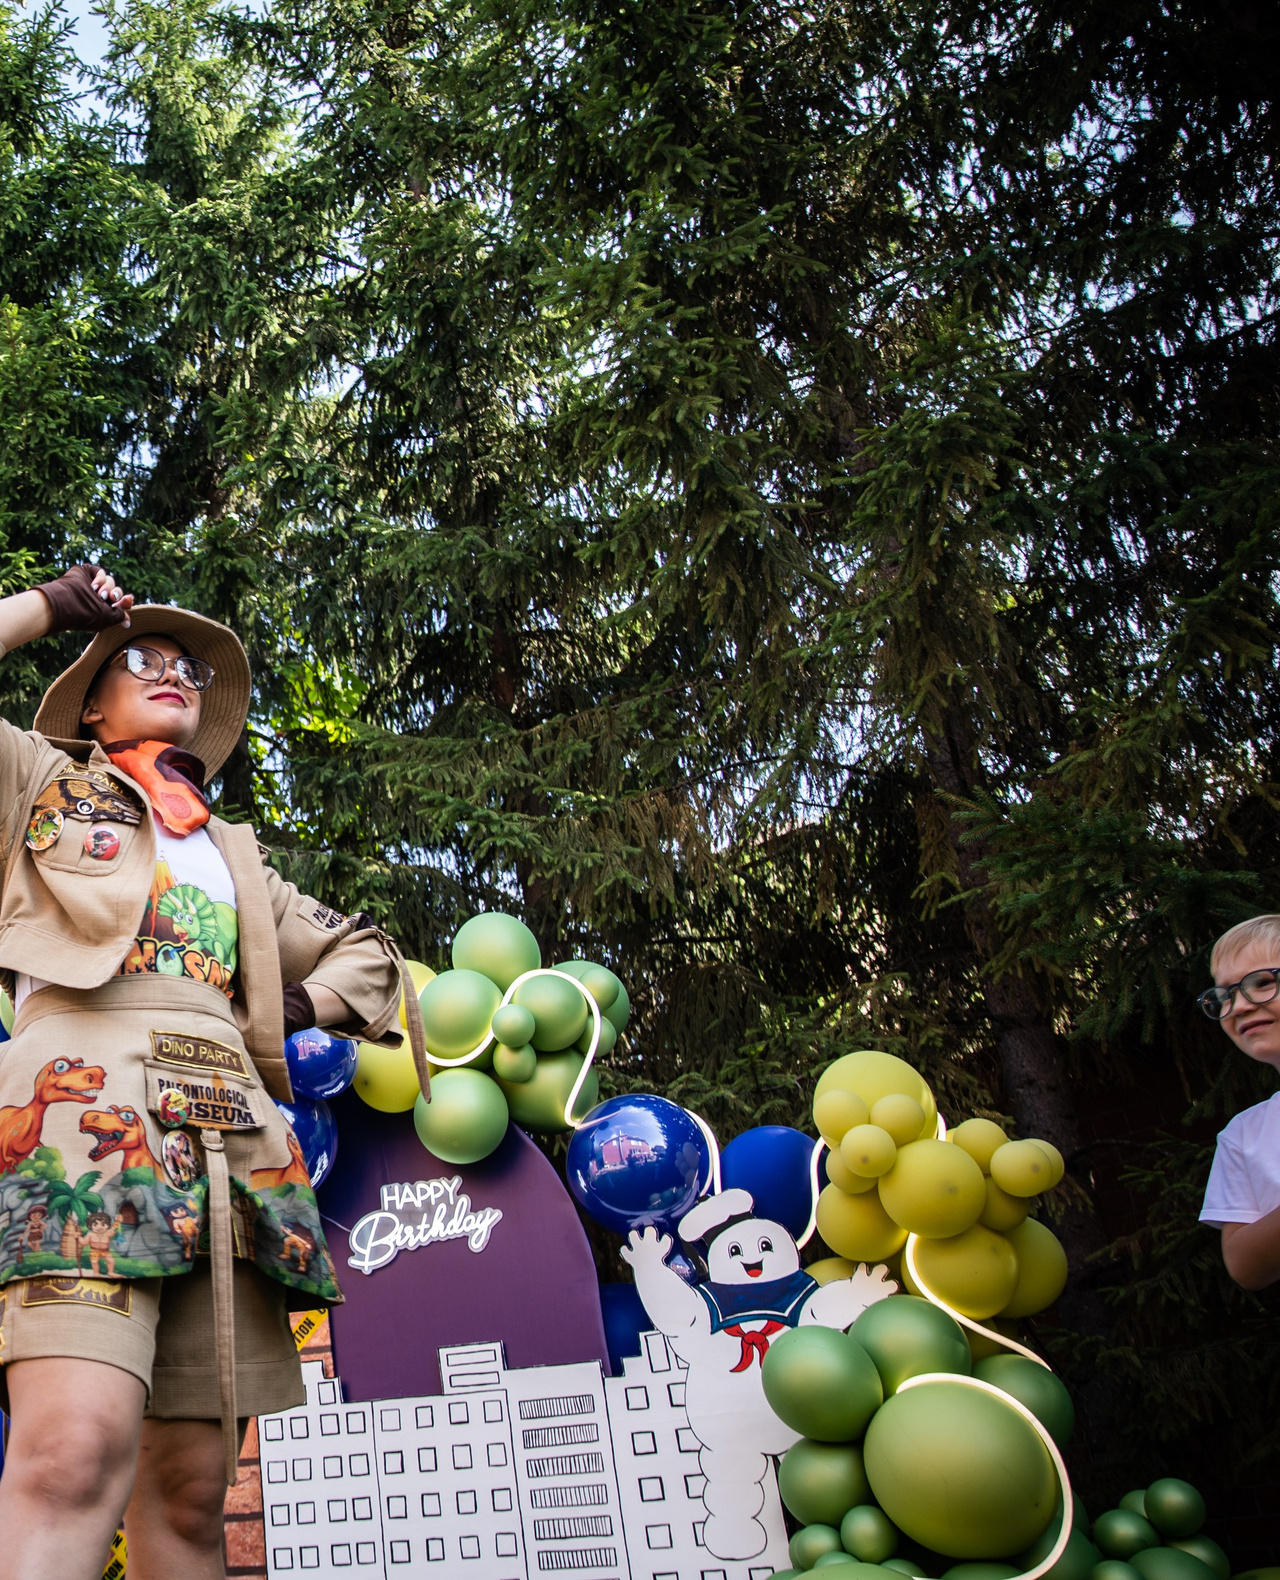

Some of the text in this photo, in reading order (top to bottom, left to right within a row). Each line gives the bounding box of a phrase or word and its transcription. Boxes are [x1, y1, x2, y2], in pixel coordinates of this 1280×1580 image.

[161, 1038, 238, 1067] DINO PARTY
[188, 1102, 256, 1124] SEUM
[383, 1177, 459, 1210] HAPPY
[350, 1196, 499, 1272] Birthday
